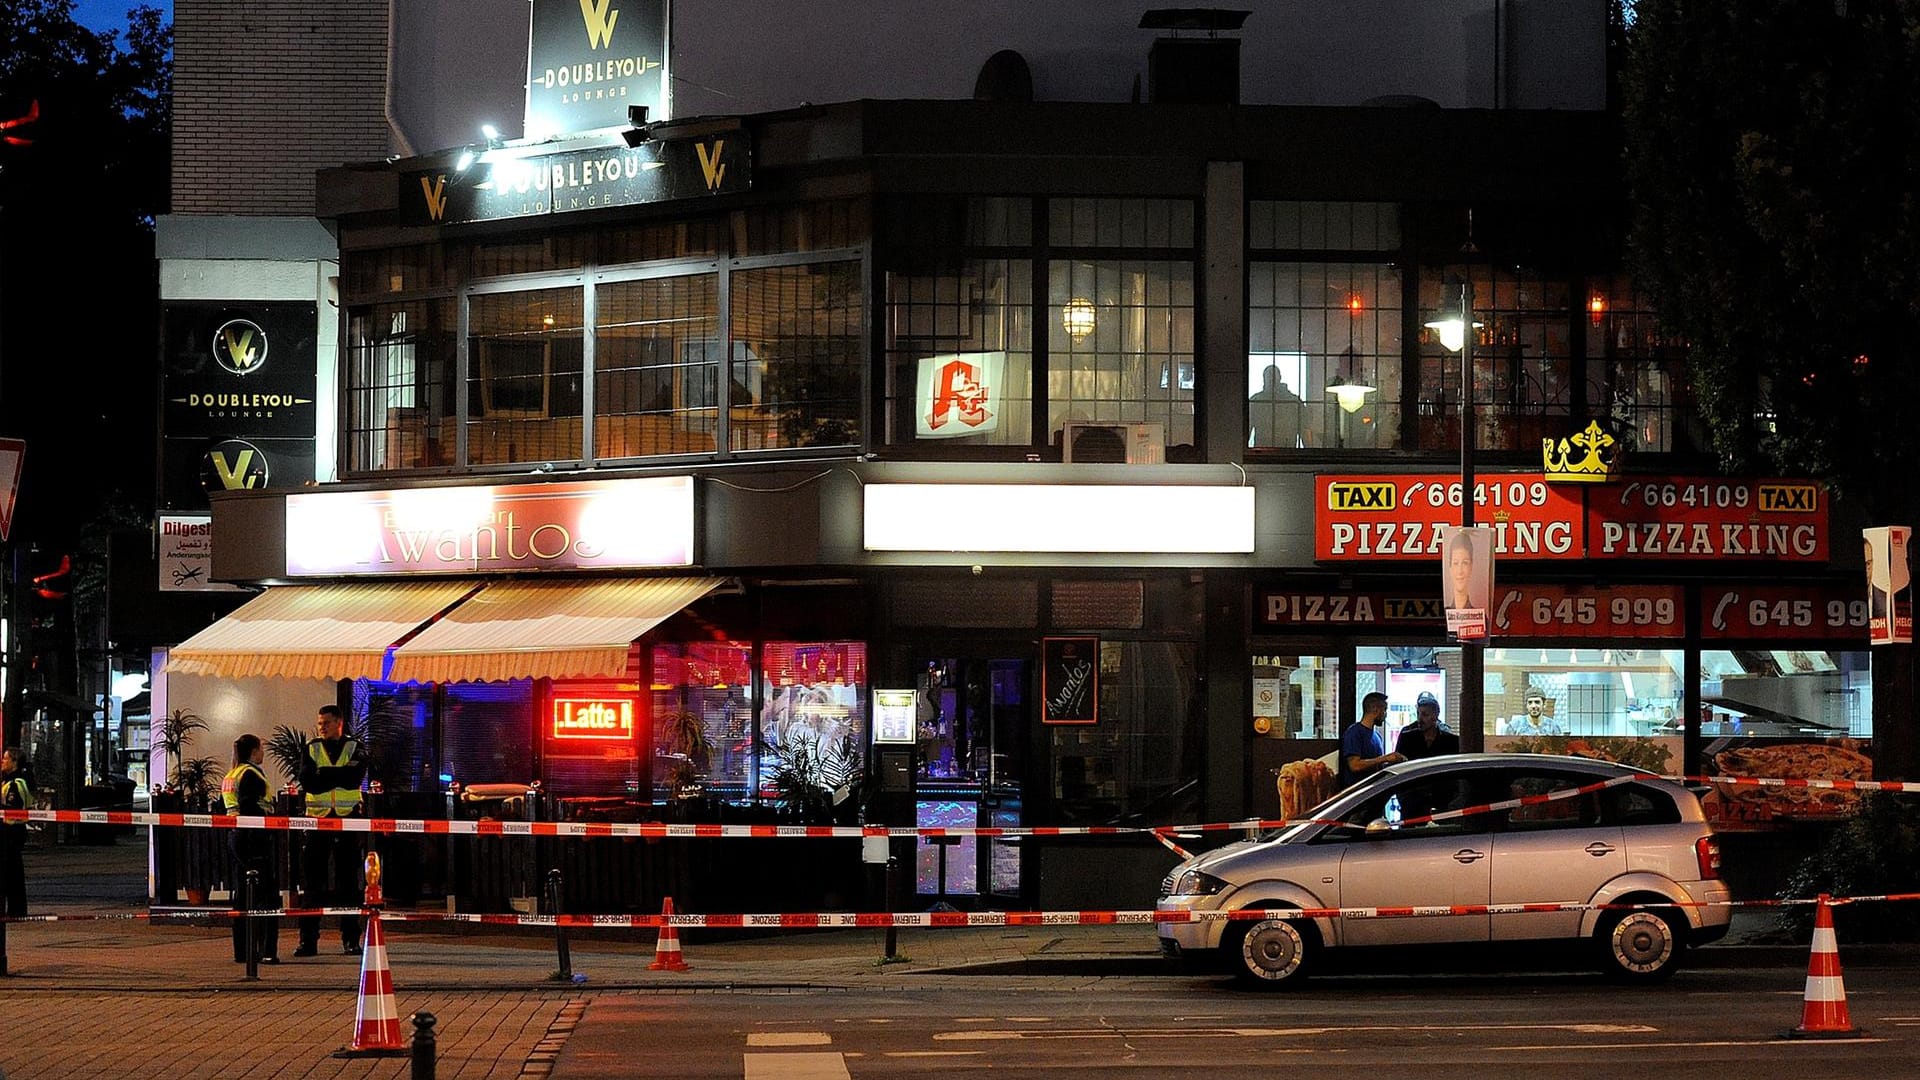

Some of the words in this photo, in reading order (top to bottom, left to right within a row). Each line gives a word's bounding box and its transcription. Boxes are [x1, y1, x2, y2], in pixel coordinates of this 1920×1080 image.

[544, 56, 647, 89] DOUBLEYOU
[562, 86, 627, 103] LOUNGE
[499, 157, 639, 195] OUBLEYOU
[523, 194, 612, 214] LOUNGE
[190, 394, 293, 407] DOUBLEYOU
[1333, 486, 1393, 507] TAXI
[1643, 484, 1749, 507] 664109
[1760, 487, 1813, 509] TAXI
[1331, 522, 1450, 554] PIZZA
[1474, 521, 1573, 554] ING
[1602, 522, 1714, 554] PIZZA
[1721, 523, 1816, 556] KING
[1267, 595, 1375, 621] PIZZA
[1386, 599, 1445, 618] TAXI
[1532, 597, 1597, 625] 645
[1611, 597, 1676, 625] 999
[1750, 599, 1812, 627] 645
[563, 702, 617, 728] Latte
